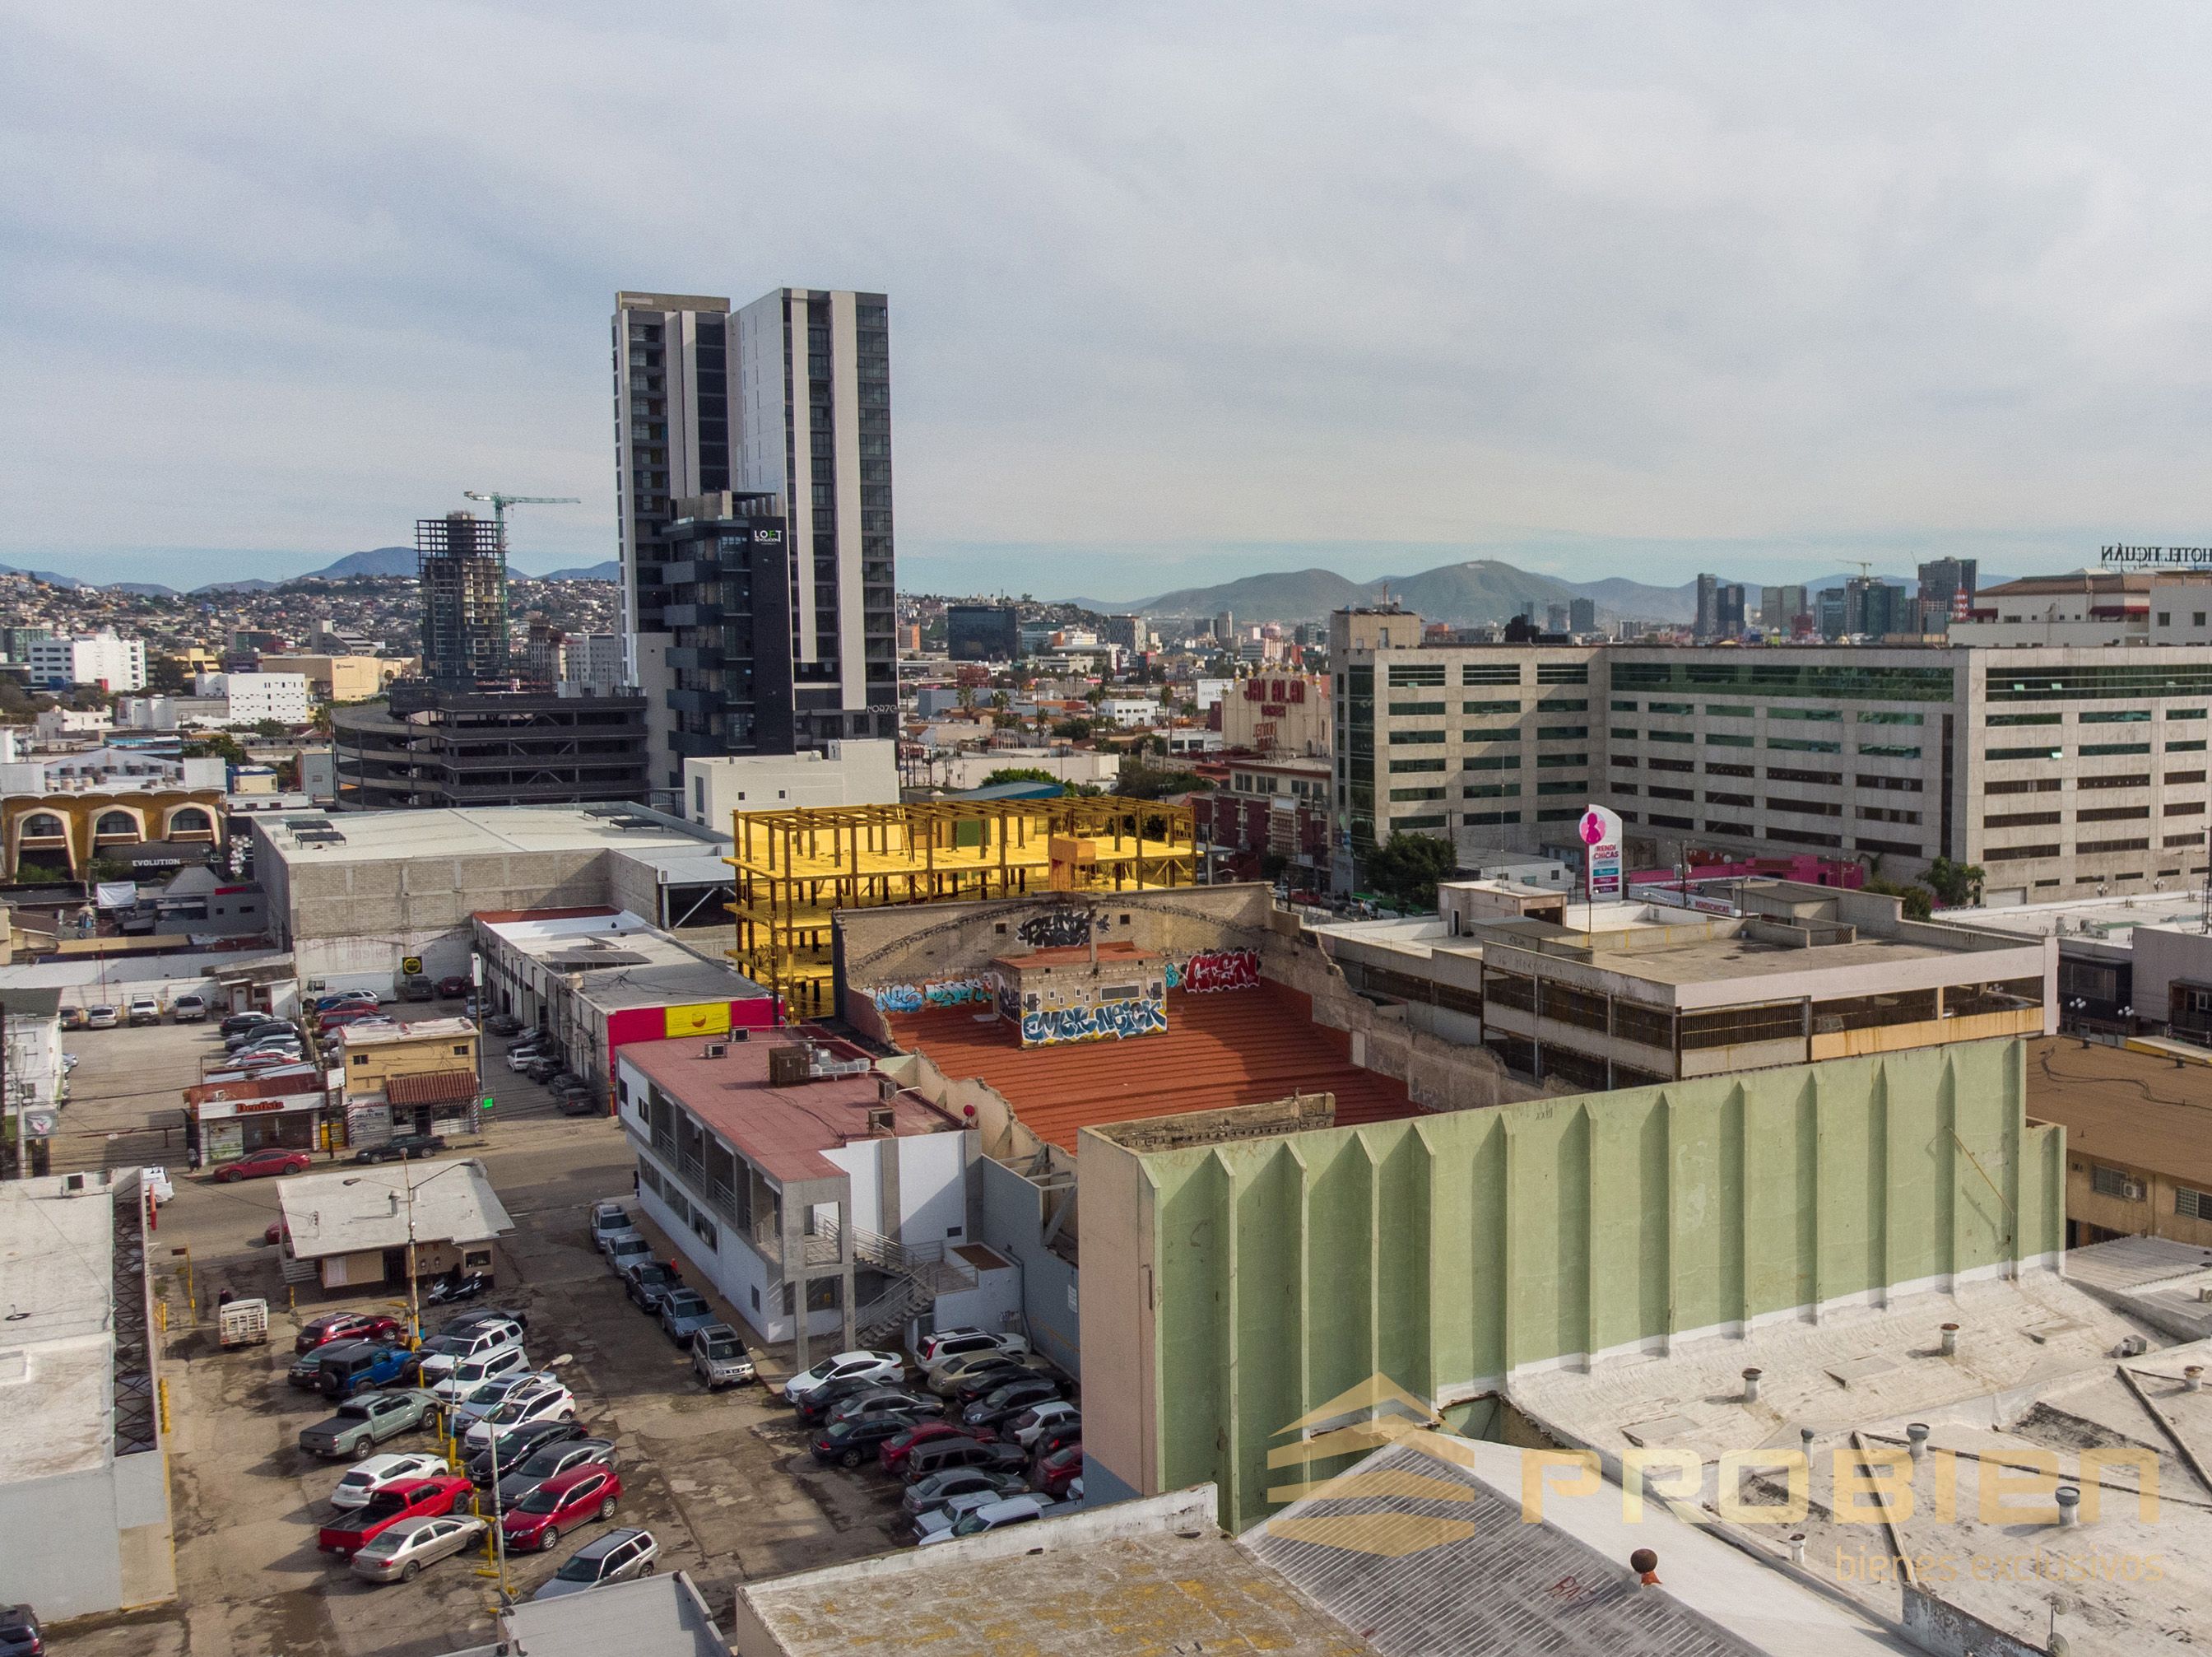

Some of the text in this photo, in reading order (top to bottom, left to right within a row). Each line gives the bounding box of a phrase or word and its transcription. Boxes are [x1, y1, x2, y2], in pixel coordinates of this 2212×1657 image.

[754, 529, 782, 542] LOFT
[1243, 678, 1266, 702] JAI
[1595, 844, 1616, 852] RENDI
[1593, 850, 1619, 860] CHICAS
[132, 859, 180, 867] EVOLUTION
[235, 1101, 285, 1114] Dentista
